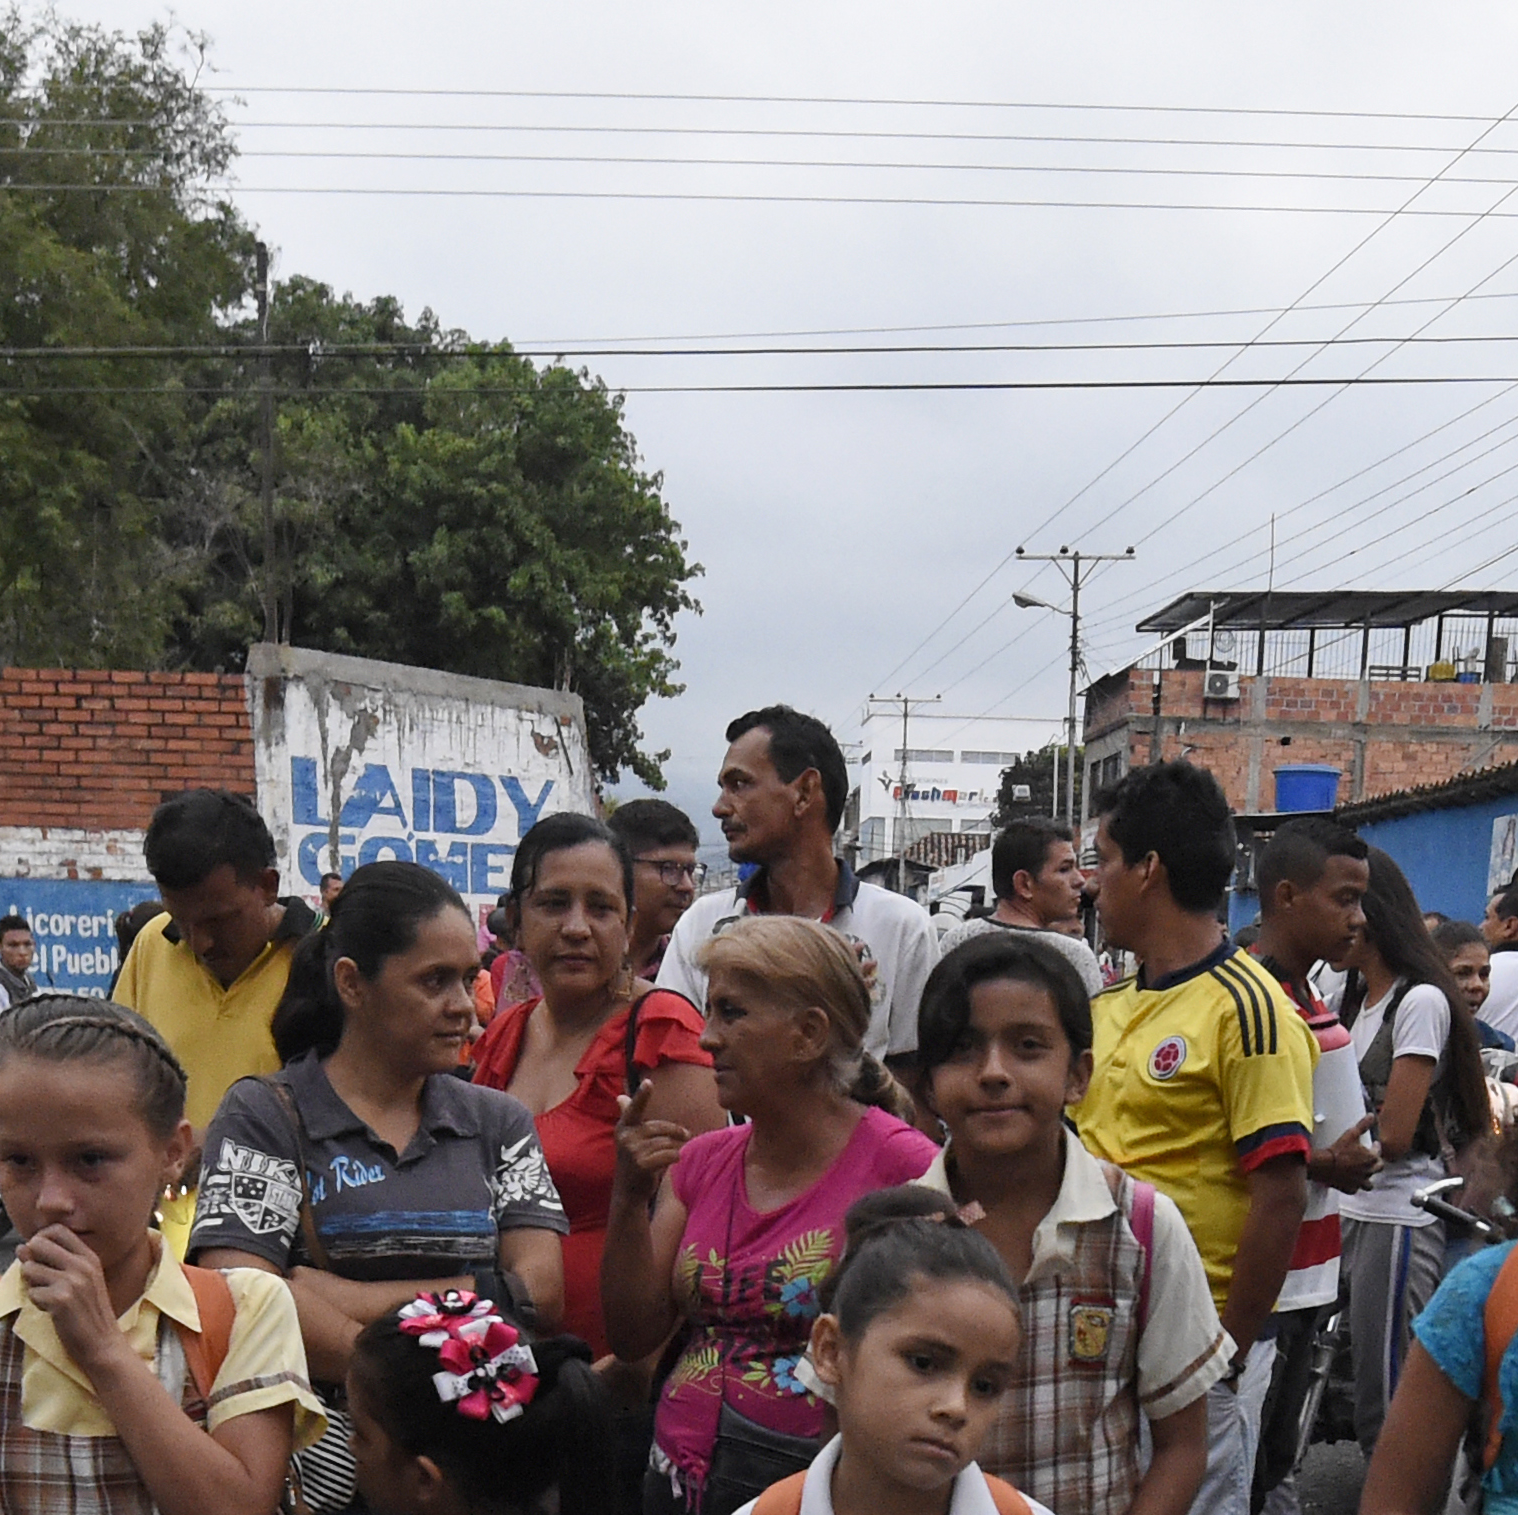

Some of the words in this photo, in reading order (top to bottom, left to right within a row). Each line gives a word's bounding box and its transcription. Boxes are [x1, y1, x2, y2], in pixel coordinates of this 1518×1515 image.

[290, 756, 555, 838] LAIDY
[298, 831, 520, 894] GÓME
[9, 903, 119, 939] icorerí
[52, 944, 121, 975] Puebl
